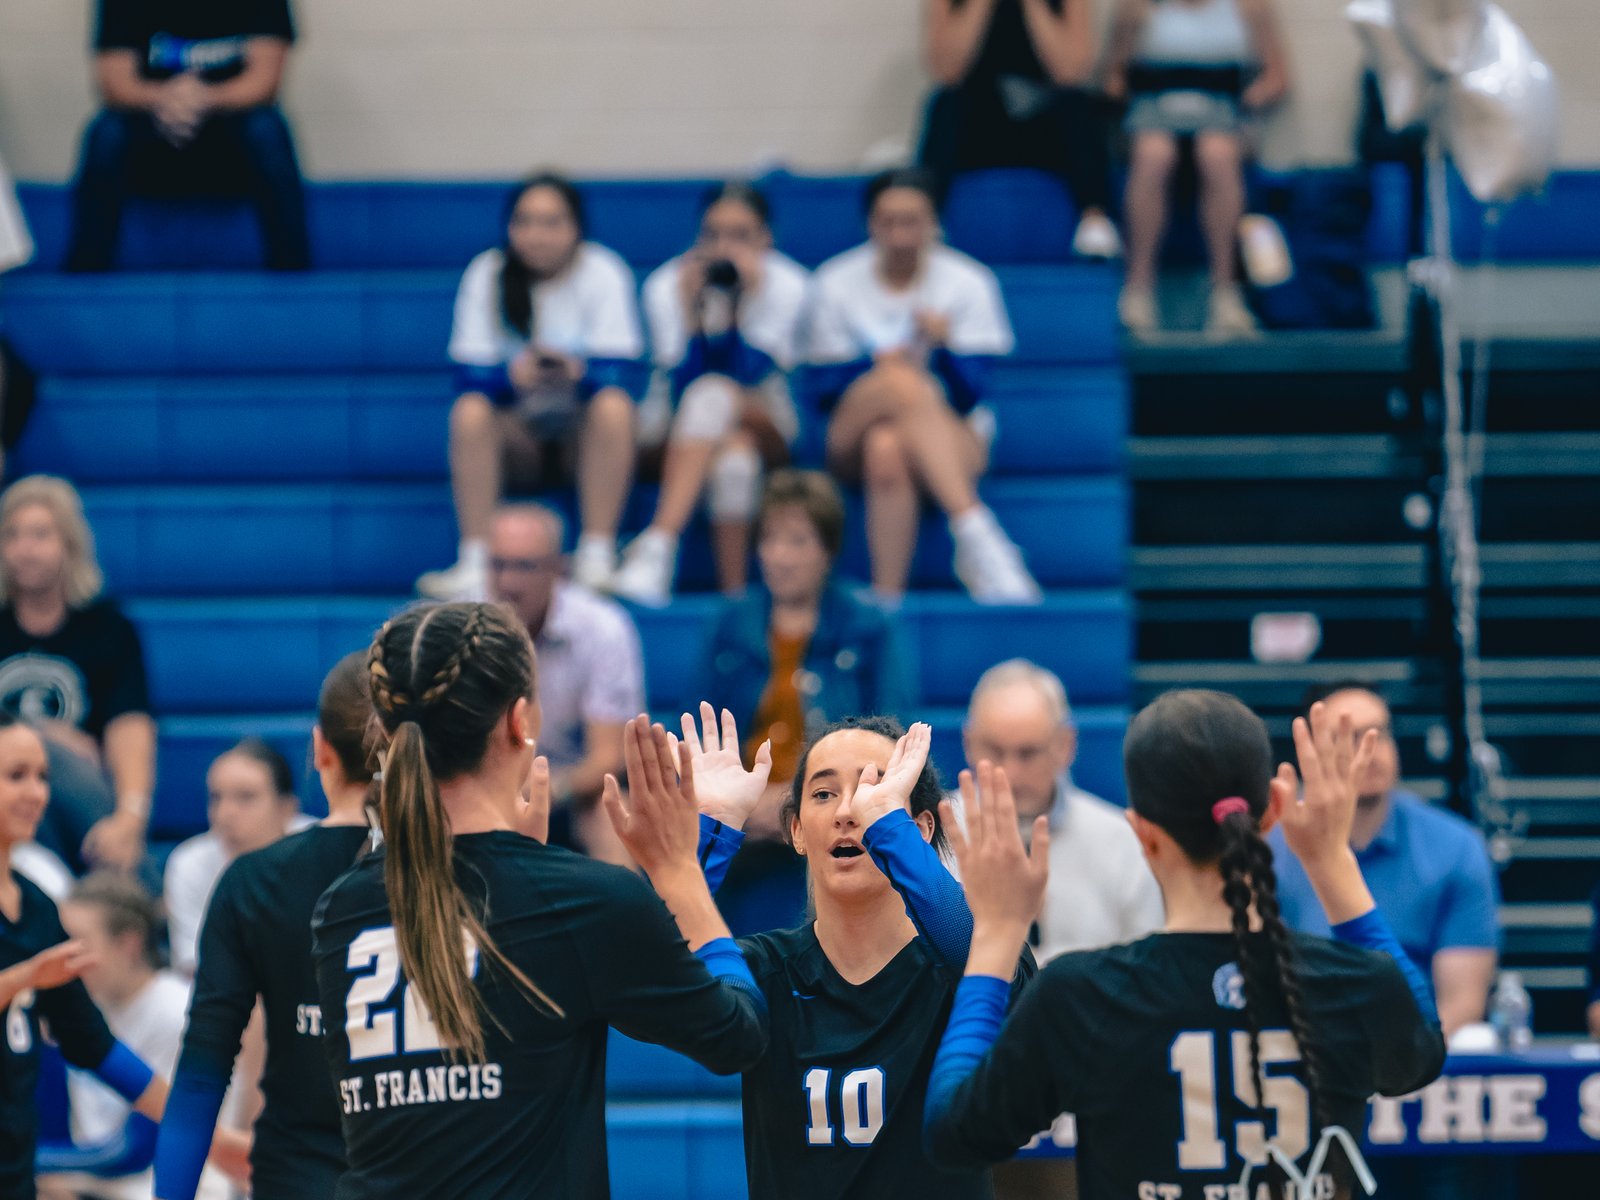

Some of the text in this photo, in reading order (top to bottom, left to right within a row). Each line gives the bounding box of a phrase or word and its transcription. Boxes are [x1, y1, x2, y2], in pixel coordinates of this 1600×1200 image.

[296, 1003, 326, 1036] ST.
[340, 1063, 502, 1114] ST. FRANCIS
[803, 1065, 887, 1147] 10
[1168, 1028, 1310, 1171] 15
[1366, 1074, 1547, 1144] THE
